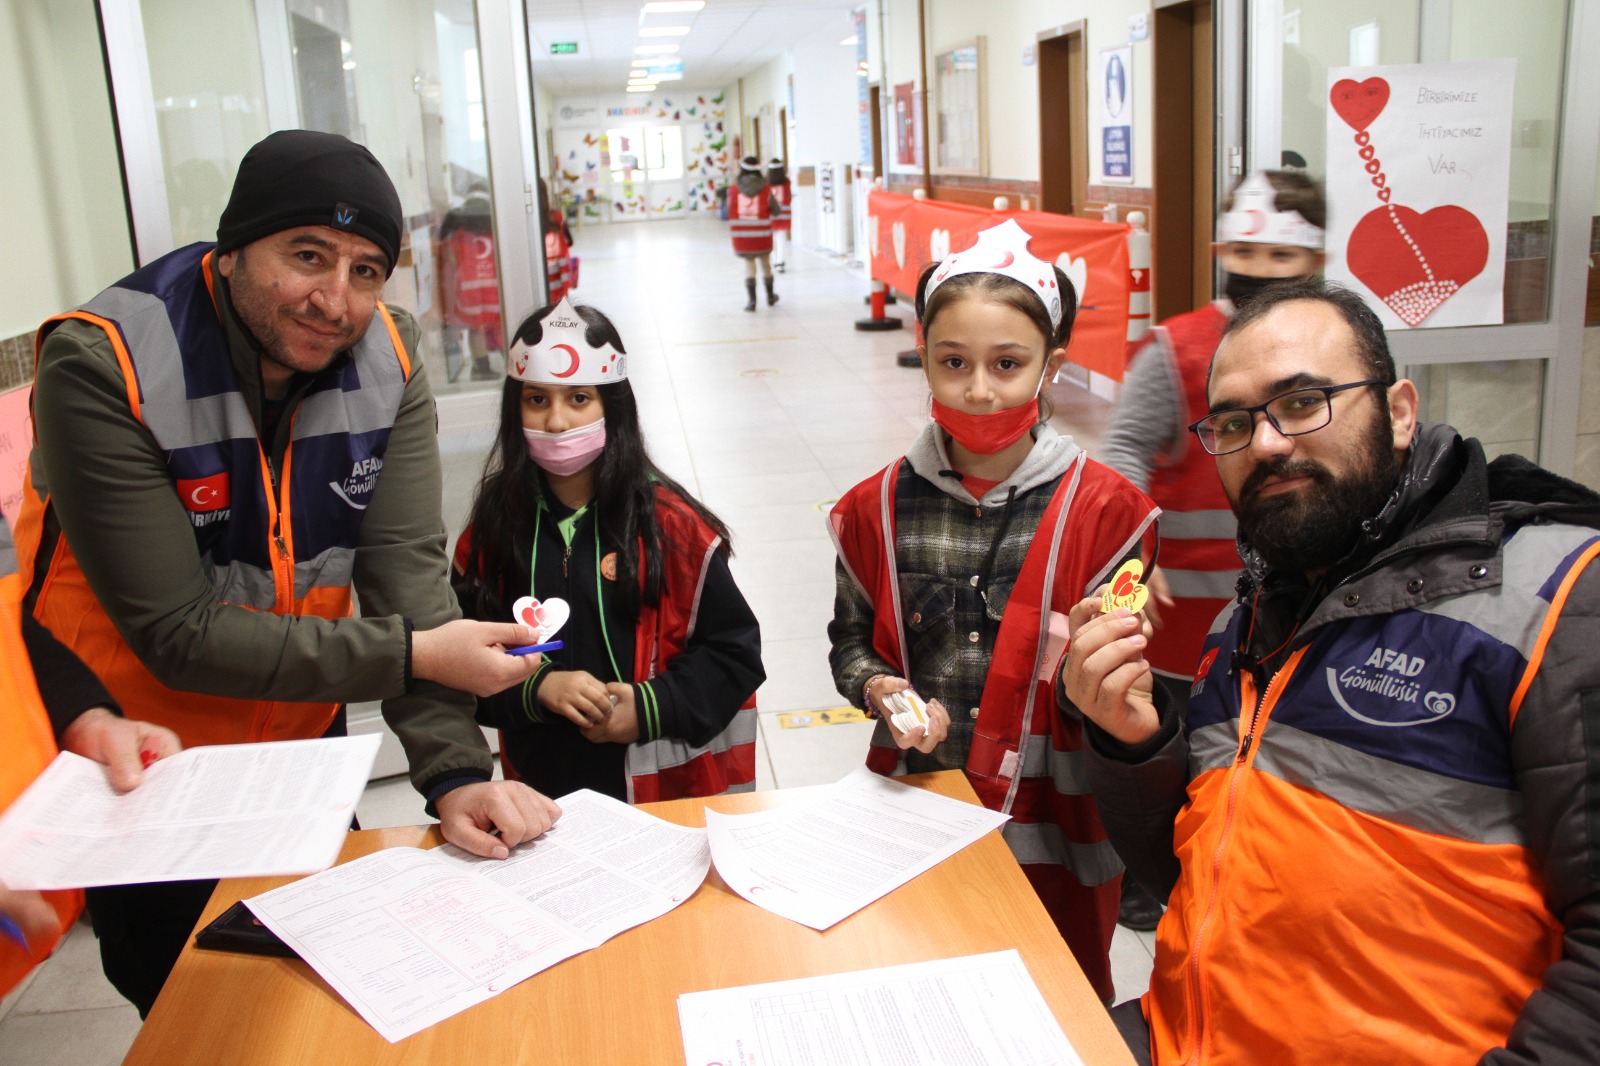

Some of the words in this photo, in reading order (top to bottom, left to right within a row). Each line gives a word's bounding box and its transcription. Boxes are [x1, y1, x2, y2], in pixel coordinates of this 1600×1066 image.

[549, 320, 578, 328] KIZILAY
[1364, 647, 1426, 677] AFAD
[1339, 665, 1421, 703] Gönüllüsü
